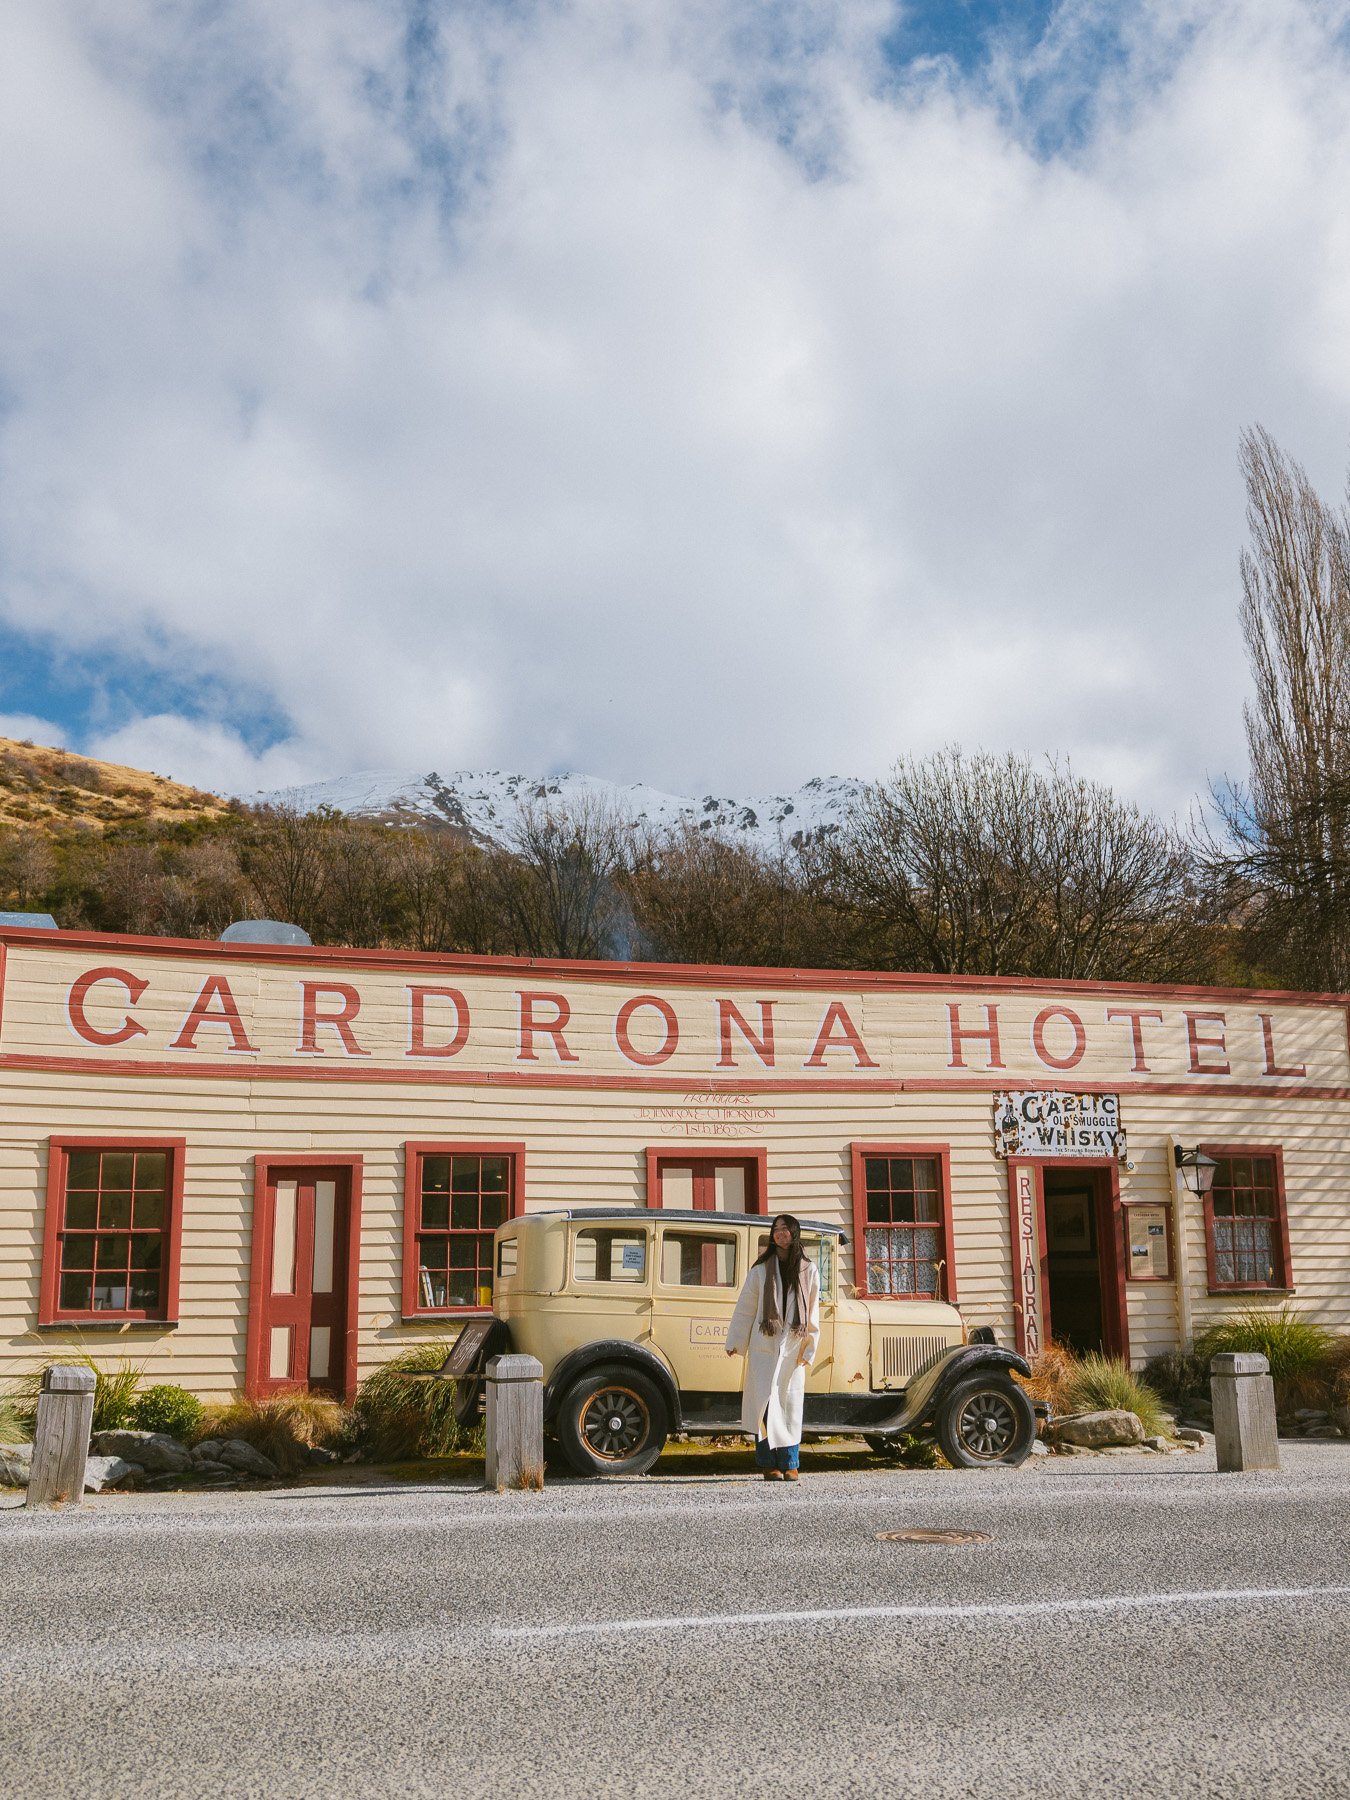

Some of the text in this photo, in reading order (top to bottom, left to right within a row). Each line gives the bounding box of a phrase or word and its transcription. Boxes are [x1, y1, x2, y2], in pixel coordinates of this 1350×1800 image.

[67, 966, 1307, 1077] CARDRONA HOTEL
[1022, 1096, 1116, 1124] GAELIC
[1036, 1126, 1118, 1147] WHISKY
